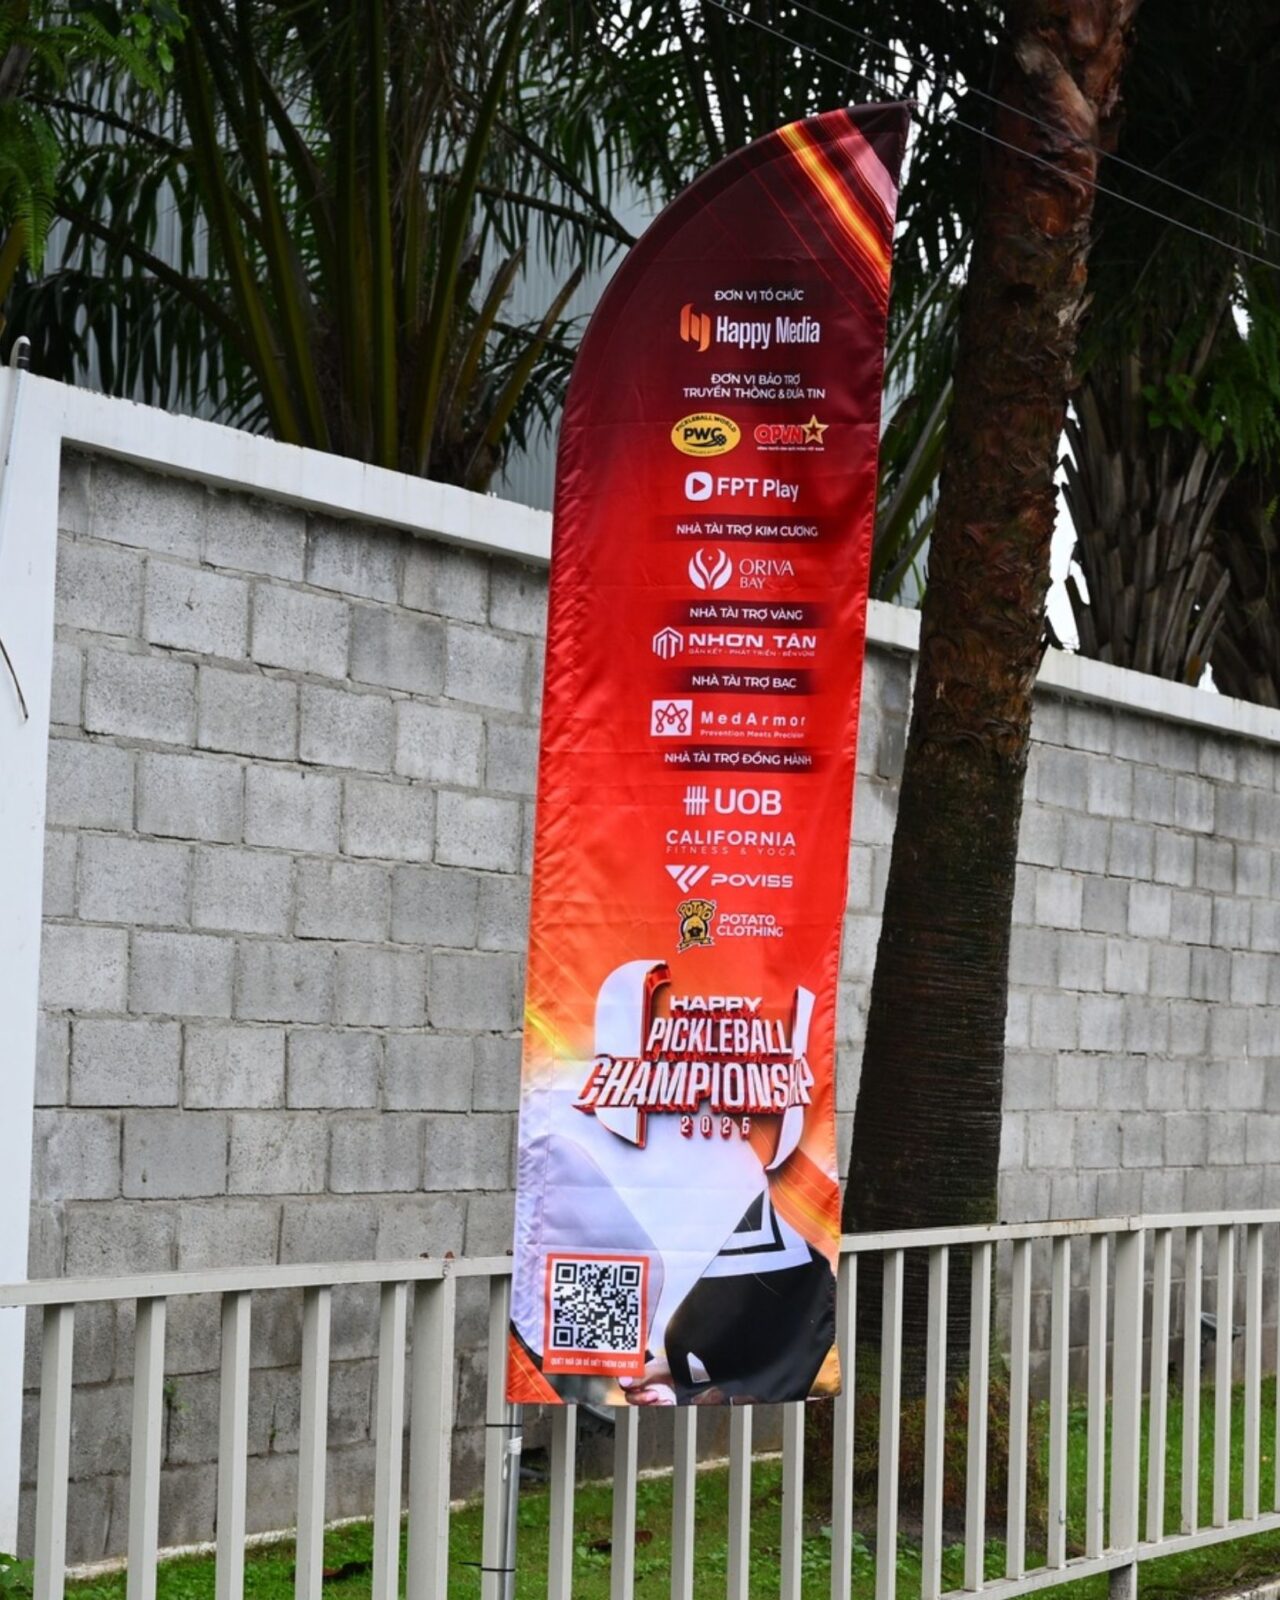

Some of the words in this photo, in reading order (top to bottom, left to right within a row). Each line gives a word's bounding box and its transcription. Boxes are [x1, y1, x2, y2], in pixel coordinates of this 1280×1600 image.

[714, 289, 743, 301] ĐƠN
[745, 290, 757, 303] VỊ
[716, 315, 771, 350] Happy
[776, 316, 821, 344] Media
[711, 373, 741, 385] ĐƠN
[807, 388, 826, 399] TIN
[717, 477, 759, 497] FPT
[762, 478, 799, 502] Play
[676, 521, 702, 535] NHÀ
[704, 522, 723, 535] TÀI
[726, 523, 753, 538] TRỢ
[755, 525, 778, 536] KIM
[779, 525, 818, 537] CƯƠNG
[739, 558, 795, 576] ORIVA
[739, 577, 766, 589] BAY
[689, 607, 717, 618] NHÀ
[720, 607, 739, 619] TÀI
[742, 608, 768, 621] TRỢ
[770, 609, 803, 620] VÀNG
[688, 633, 764, 648] NHƠN
[772, 632, 817, 649] TÂN
[692, 675, 719, 686] NHÀ
[722, 675, 740, 687] TÀI
[744, 676, 770, 690] TRỢ
[772, 677, 797, 691] BẠC
[664, 751, 691, 763] NHÀ
[693, 752, 711, 763] TÀI
[714, 753, 740, 766] TRỢ
[783, 753, 812, 765] HÀNH
[714, 788, 782, 815] UOB
[666, 830, 796, 847] CALIFORNIA
[666, 846, 729, 854] FITNESS
[711, 873, 793, 888] POVISS
[719, 913, 776, 926] POTATO
[716, 925, 784, 938] CLOTHING
[669, 995, 762, 1012] HAPPY
[646, 1017, 793, 1054] PICKLEBALL
[680, 1115, 750, 1135] 2025
